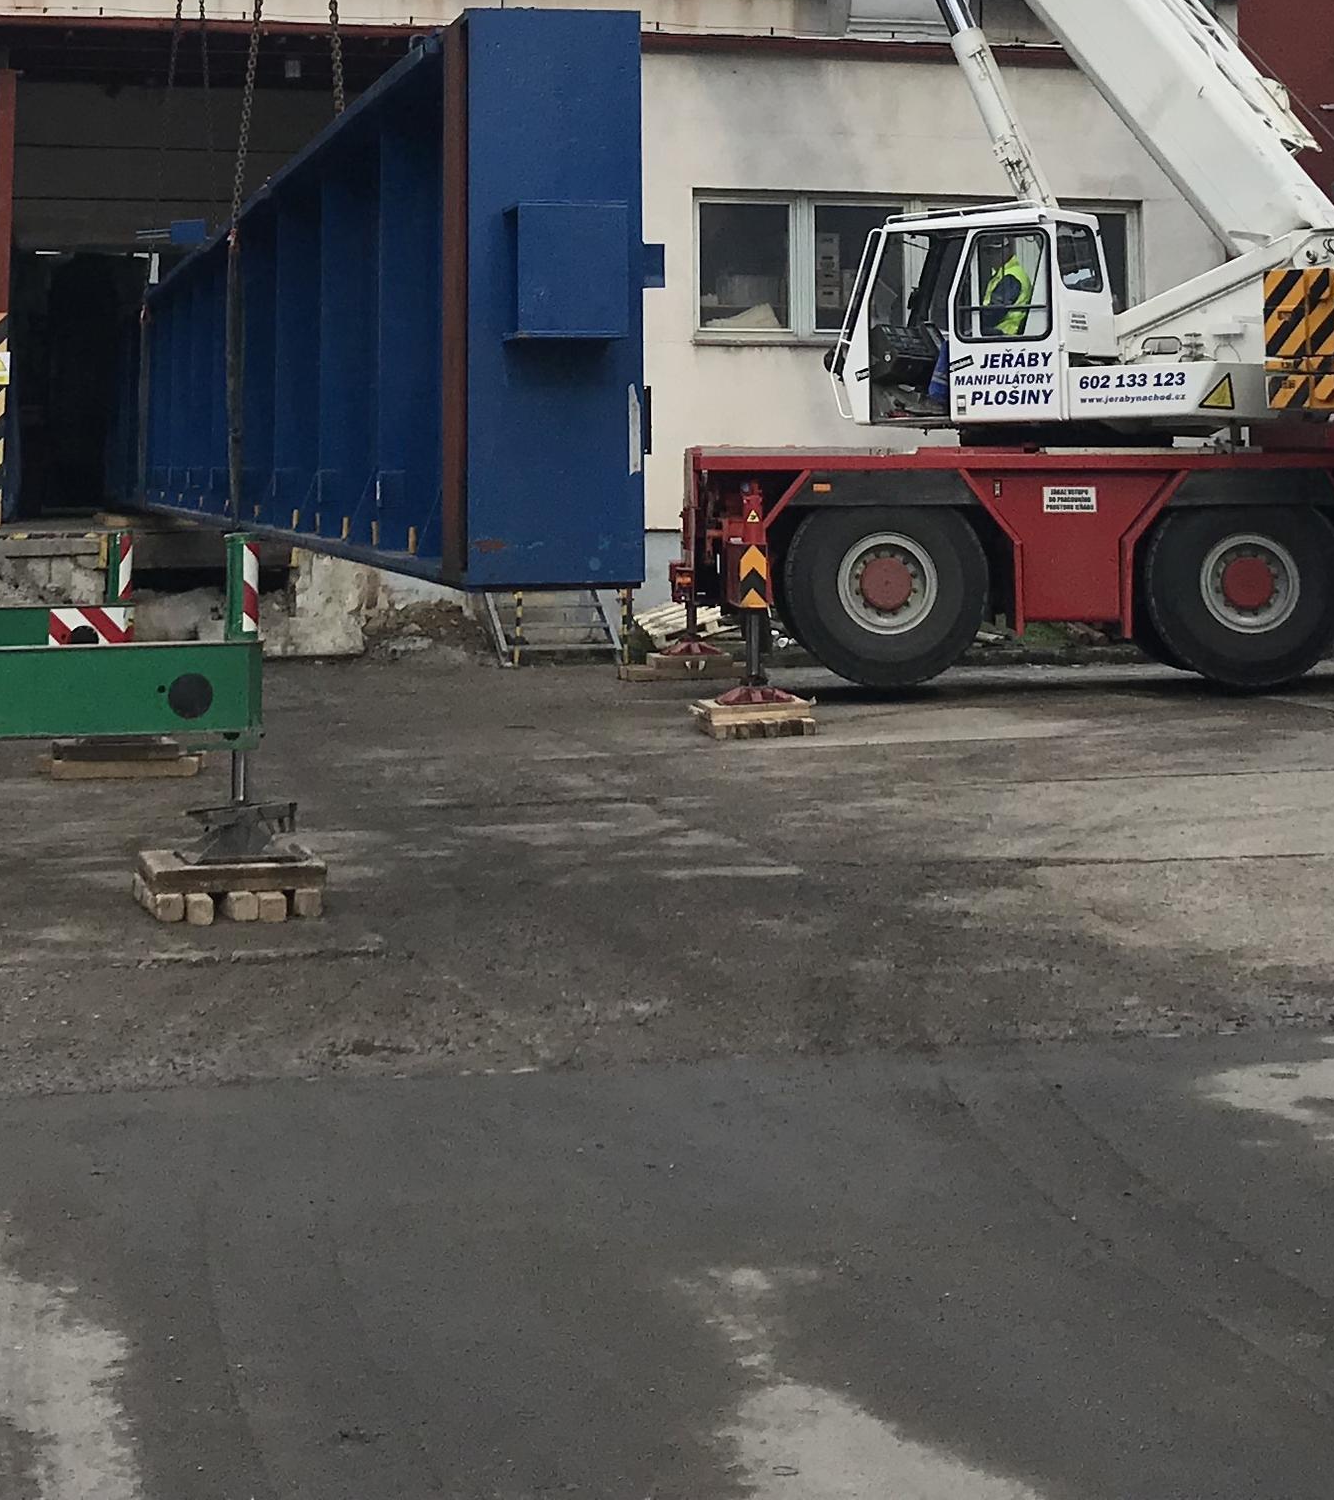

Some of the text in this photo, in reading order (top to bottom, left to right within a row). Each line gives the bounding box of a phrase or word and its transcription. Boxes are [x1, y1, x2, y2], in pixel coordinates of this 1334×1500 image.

[980, 348, 1053, 369] JEŘÁBY
[954, 370, 1054, 386] MANIPULÁTORY
[1079, 371, 1186, 390] 602 133 123
[971, 385, 1054, 406] PLOŠINY
[1079, 393, 1187, 405] www.jerabynachod.cz
